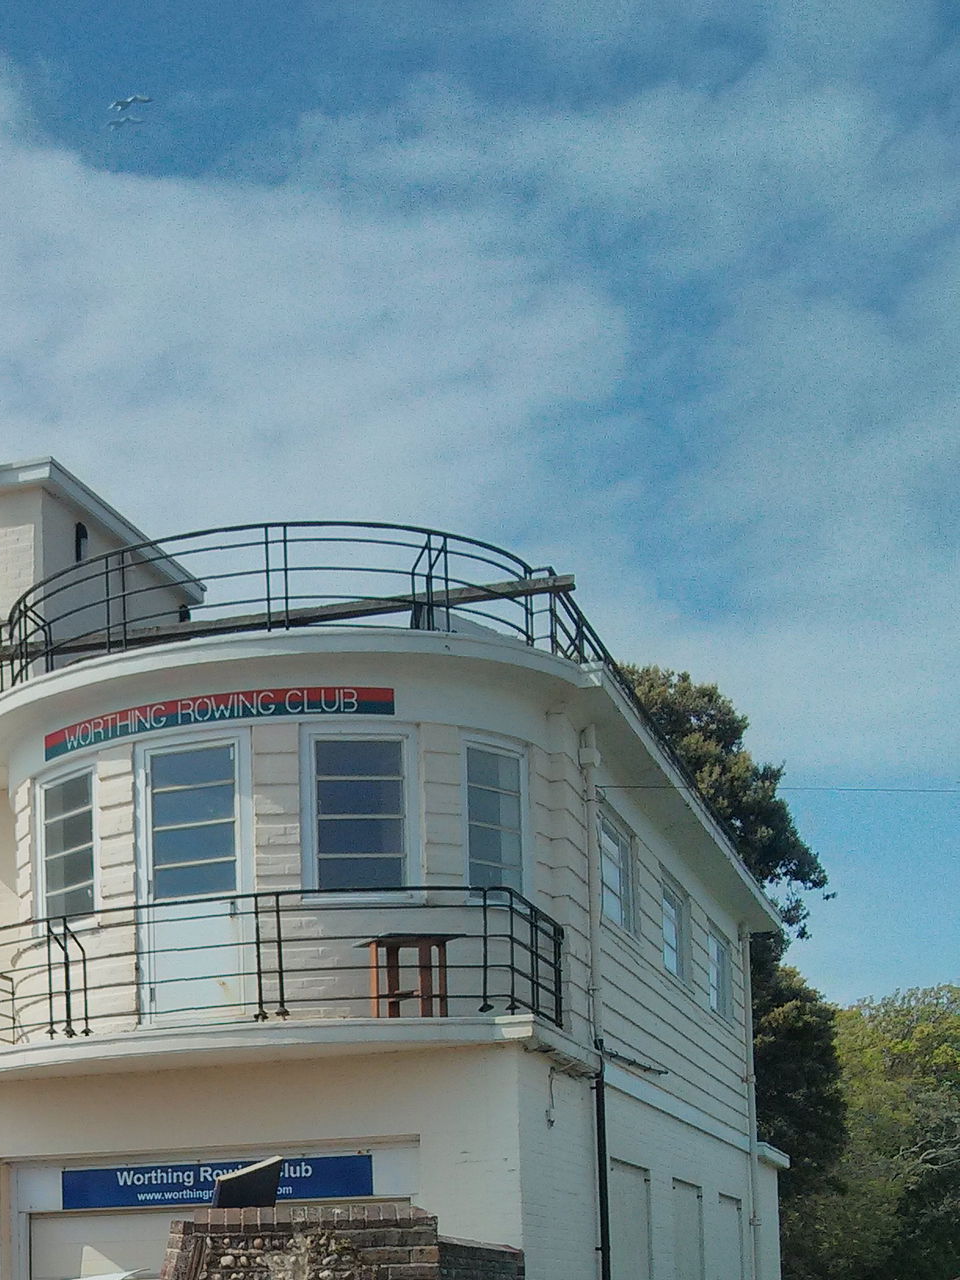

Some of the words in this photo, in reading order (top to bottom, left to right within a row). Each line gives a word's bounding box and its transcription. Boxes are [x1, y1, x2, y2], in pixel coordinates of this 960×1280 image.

[64, 704, 167, 751] WORTHING
[177, 691, 276, 724] ROWING
[285, 688, 358, 713] CLUB
[116, 1168, 194, 1187] Worthing
[279, 1161, 313, 1178] lub
